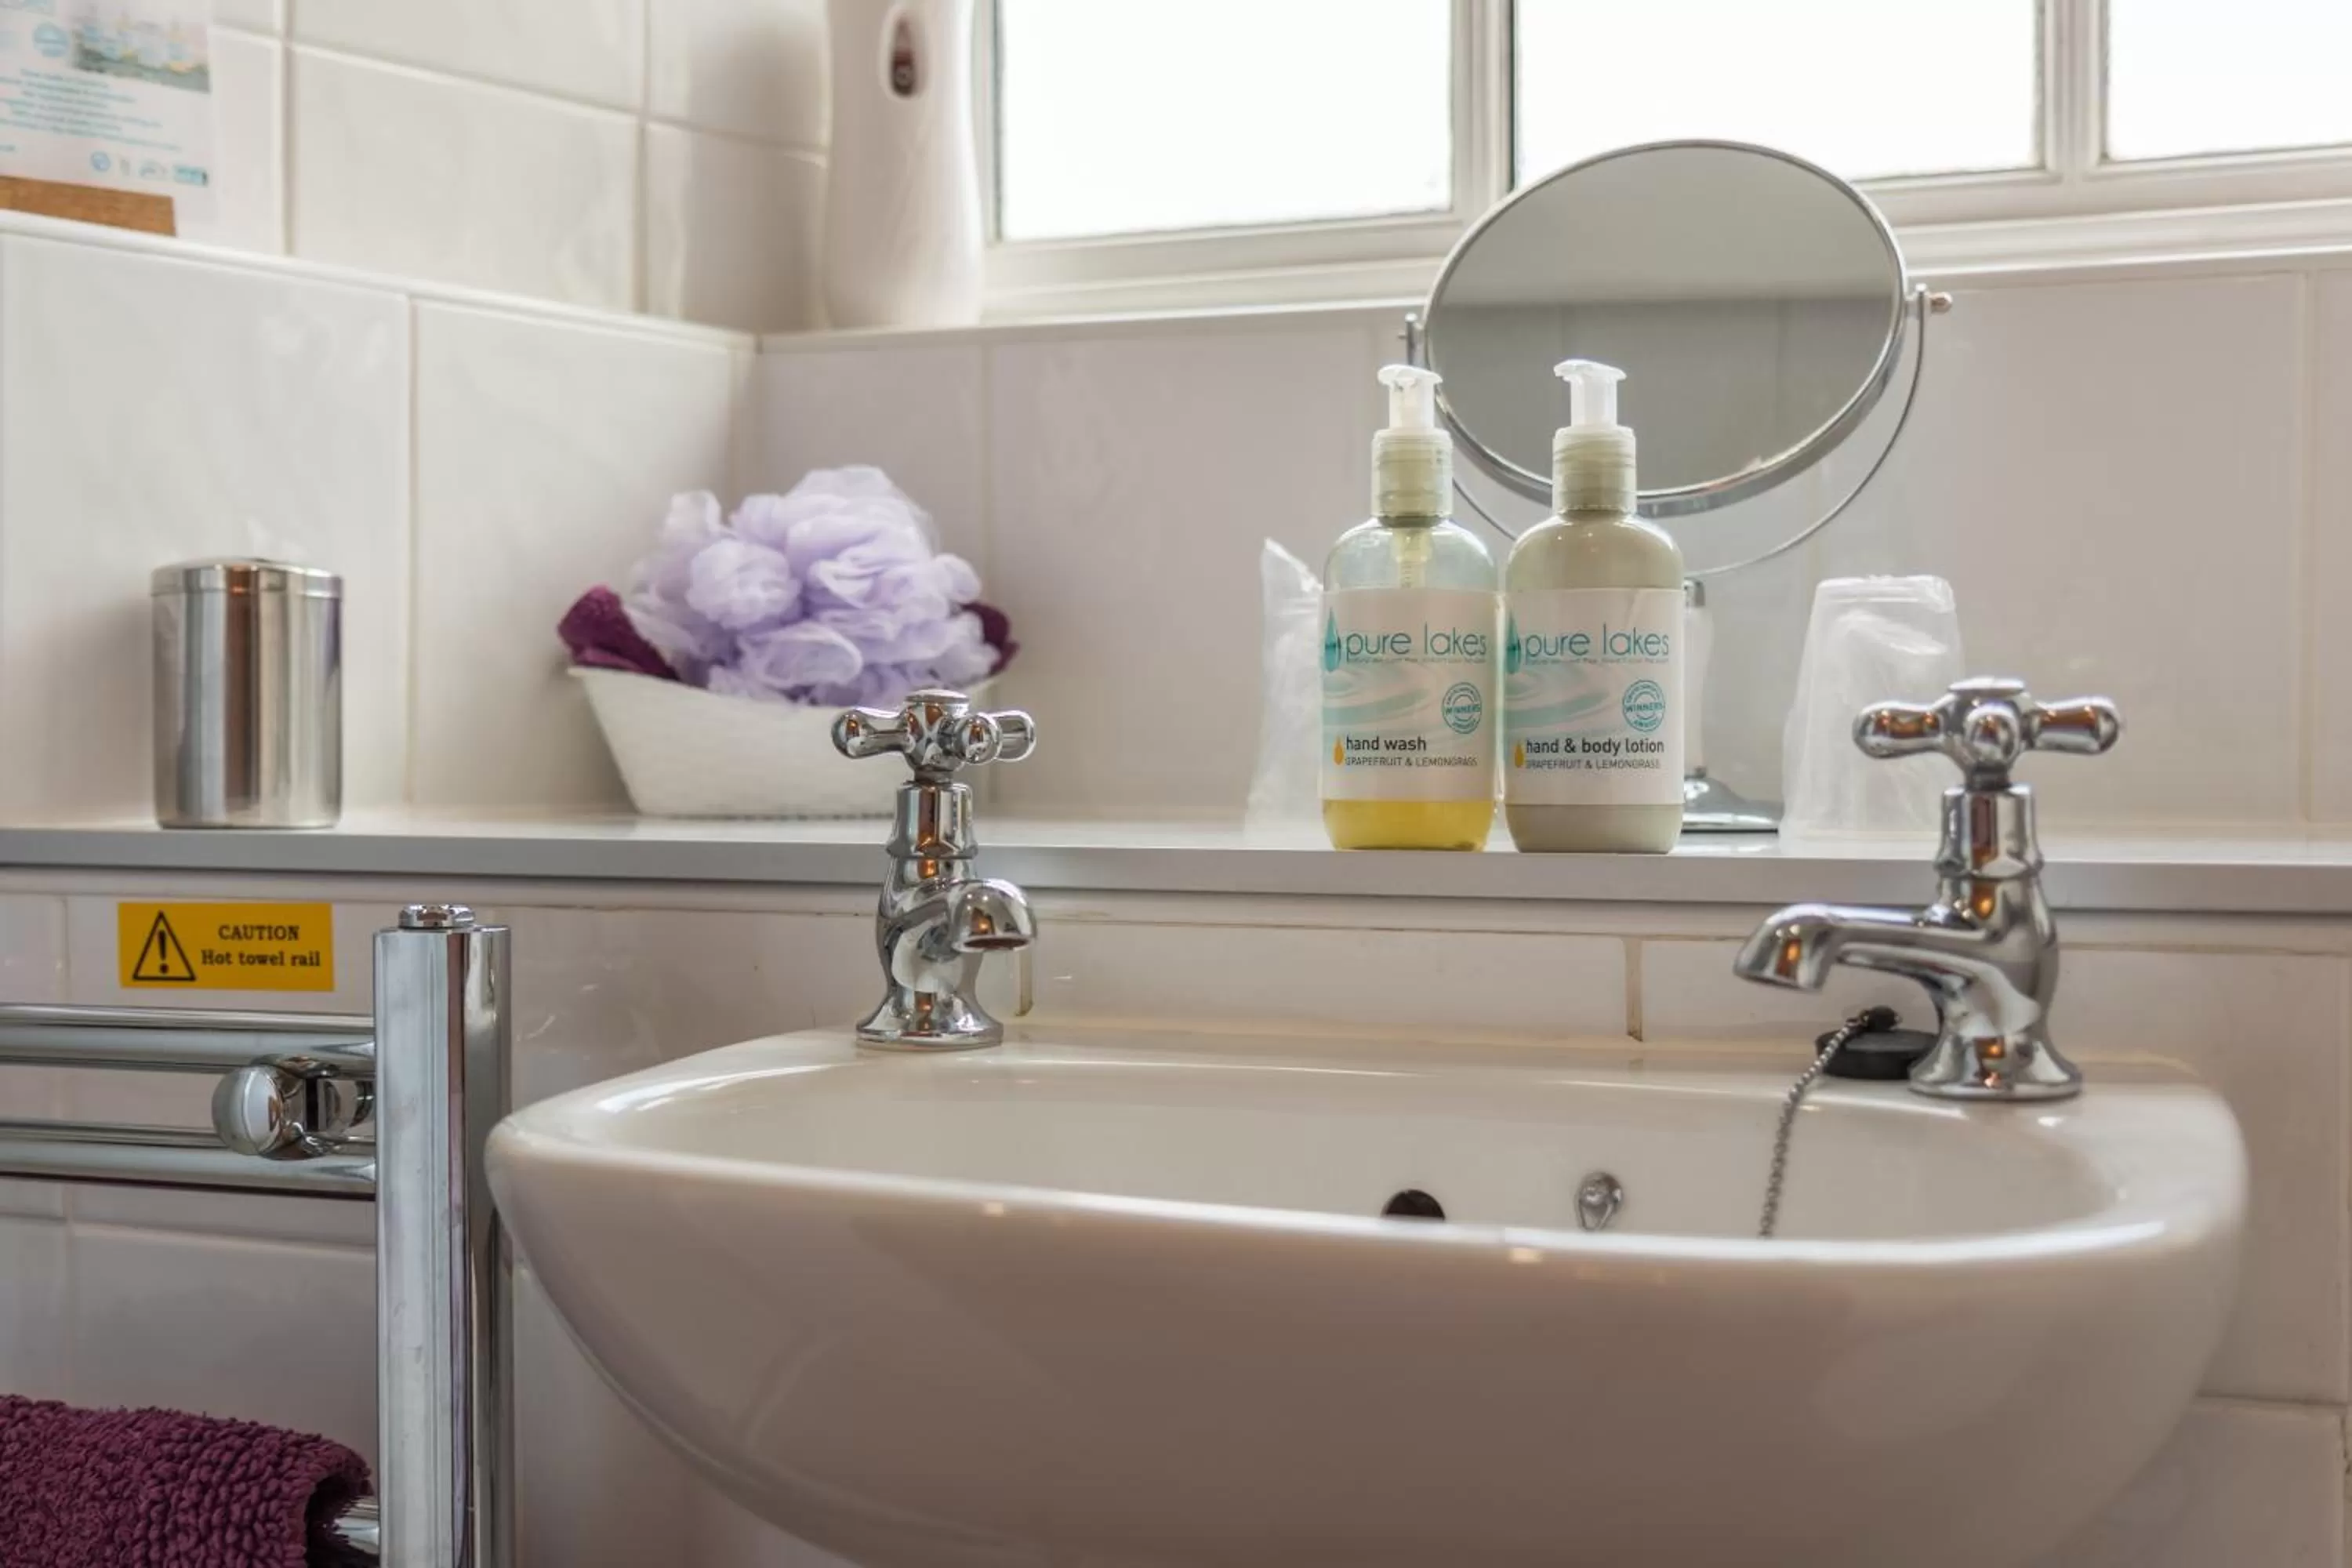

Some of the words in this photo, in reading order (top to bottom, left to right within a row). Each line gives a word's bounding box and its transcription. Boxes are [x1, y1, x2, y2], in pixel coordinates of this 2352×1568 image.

[1345, 632, 1411, 663] pure
[1424, 621, 1487, 656] lakes
[1525, 632, 1591, 665] pure
[1602, 622, 1669, 656] lakes
[1345, 735, 1380, 751] hand
[1384, 735, 1427, 751] wash
[1526, 738, 1559, 753] hand
[1564, 738, 1577, 753] &
[1581, 738, 1621, 757] body
[1625, 738, 1664, 753] lotion
[1345, 756, 1402, 767] GRAPEFRUIT
[1404, 756, 1413, 767] &
[1414, 756, 1478, 768] LEMONGRASS
[1525, 758, 1581, 770] GRAPEFRUIT
[1585, 759, 1592, 769] &
[1595, 758, 1661, 770] LEMONGRASS
[218, 924, 299, 941] CAUTION
[201, 949, 233, 966] Hot
[238, 950, 285, 967] towel
[290, 951, 321, 967] rail
